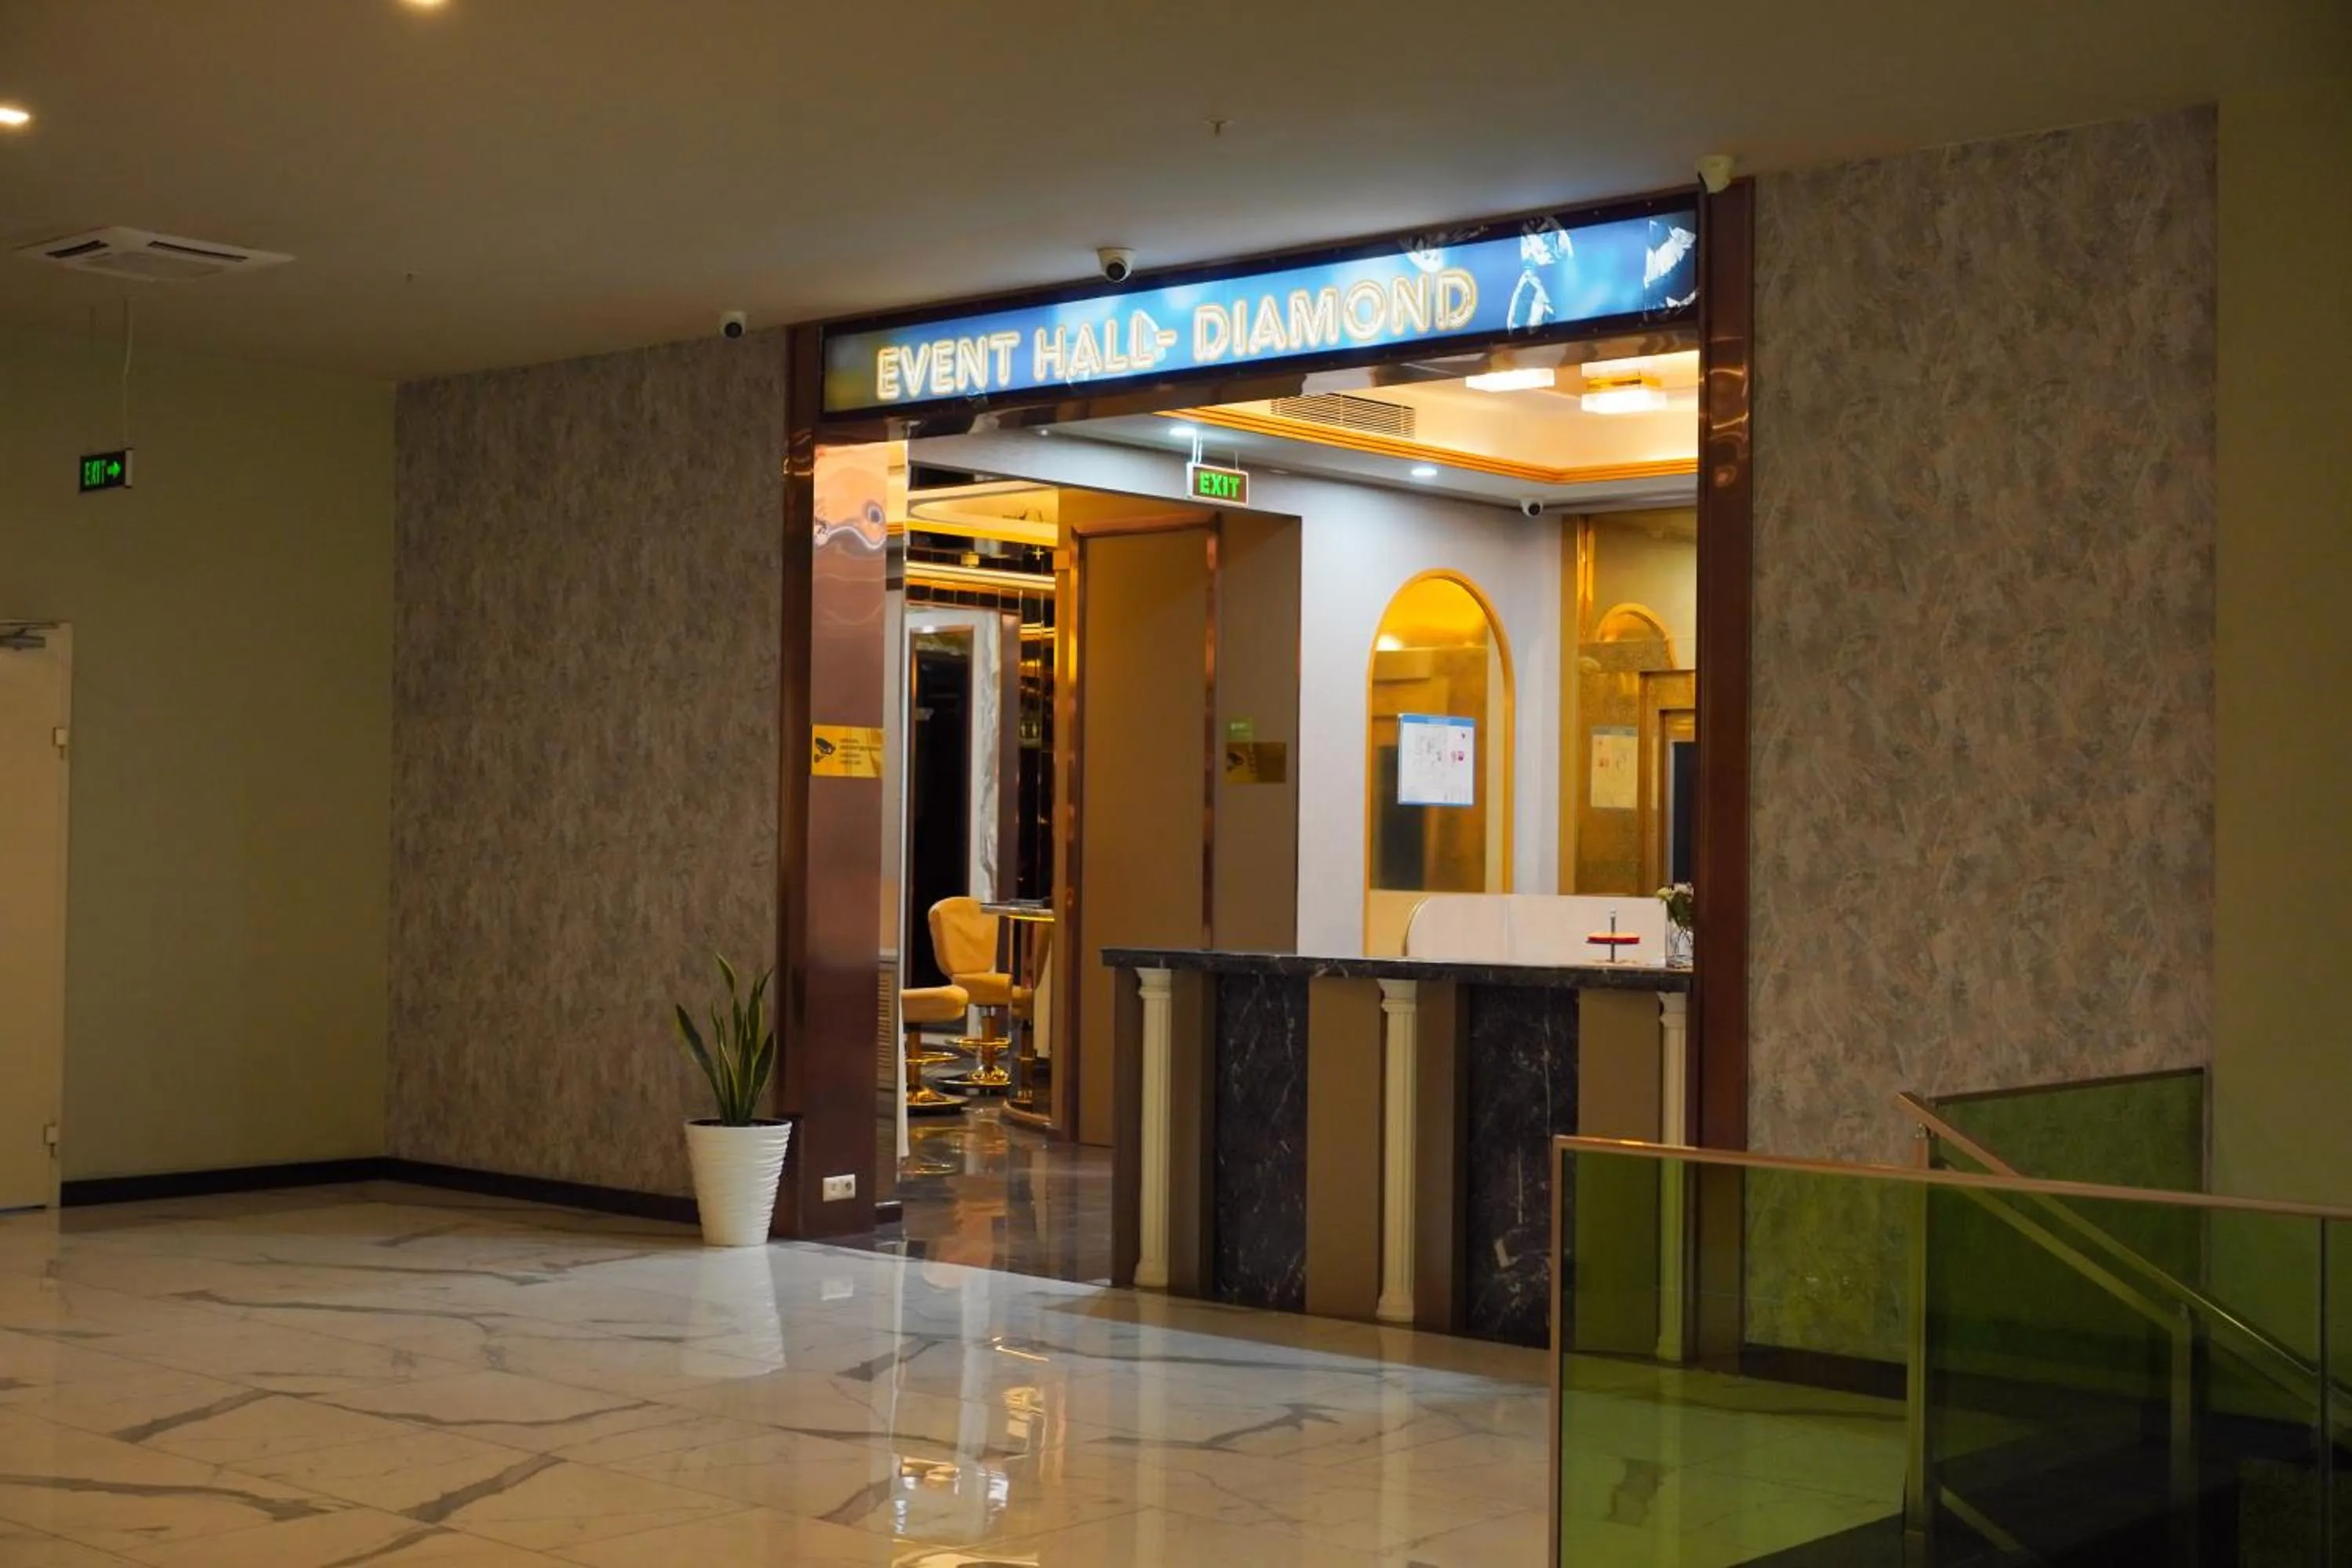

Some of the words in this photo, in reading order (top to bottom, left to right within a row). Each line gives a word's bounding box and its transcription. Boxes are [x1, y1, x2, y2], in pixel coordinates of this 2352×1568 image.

[877, 331, 1021, 401] EVENT
[1192, 268, 1478, 362] DIAMOND
[85, 460, 107, 485] EXIT
[1200, 471, 1240, 498] EXIT
